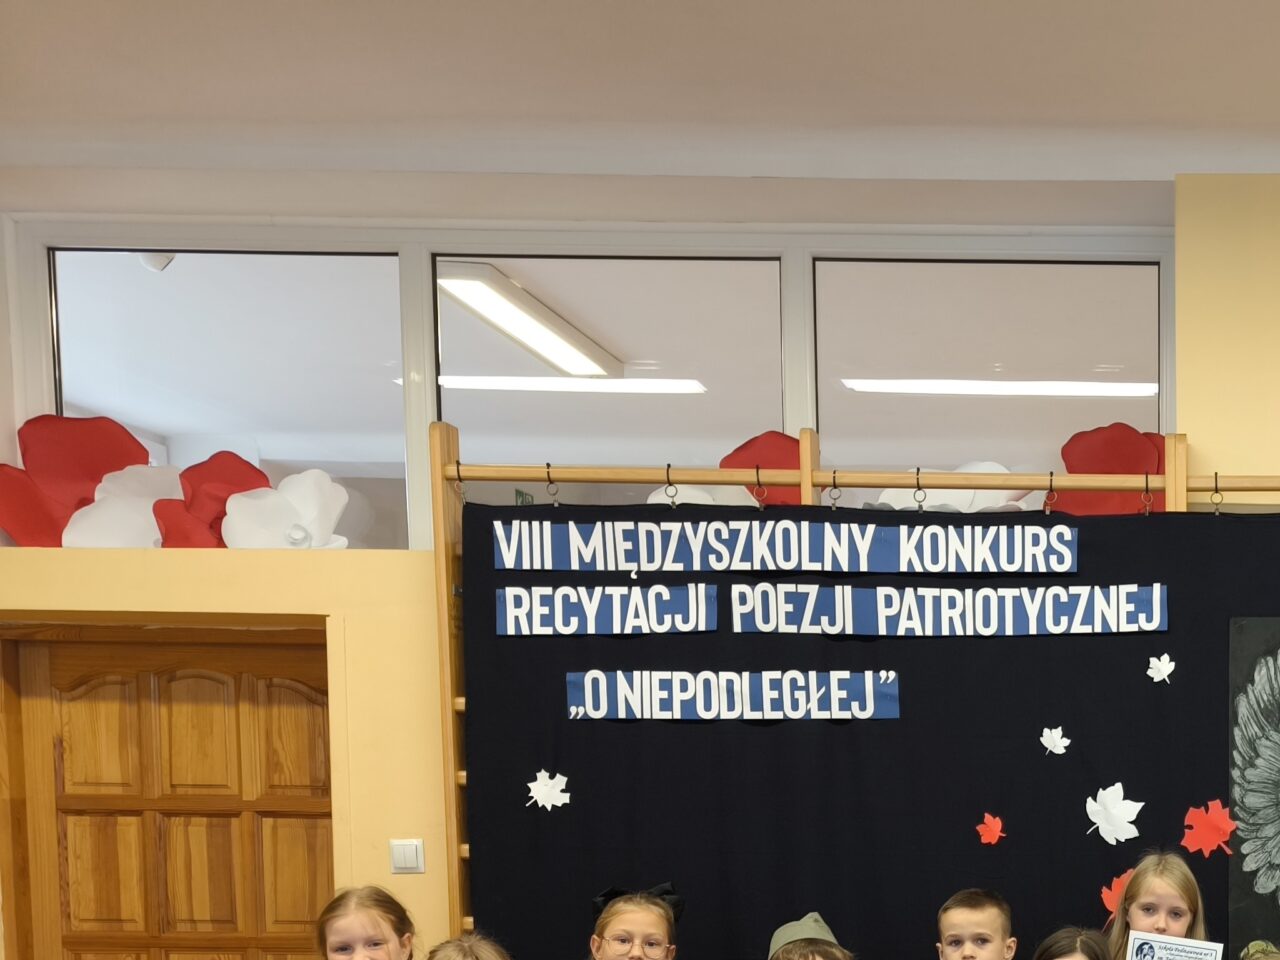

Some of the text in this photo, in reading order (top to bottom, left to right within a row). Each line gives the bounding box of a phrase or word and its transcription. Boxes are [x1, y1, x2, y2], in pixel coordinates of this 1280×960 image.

[493, 520, 1073, 579] VIII MIĘDZYSZKOLNY KONKURS
[505, 582, 1161, 636] RECYTACJI POEZJI PATRIOTYCZNEJ
